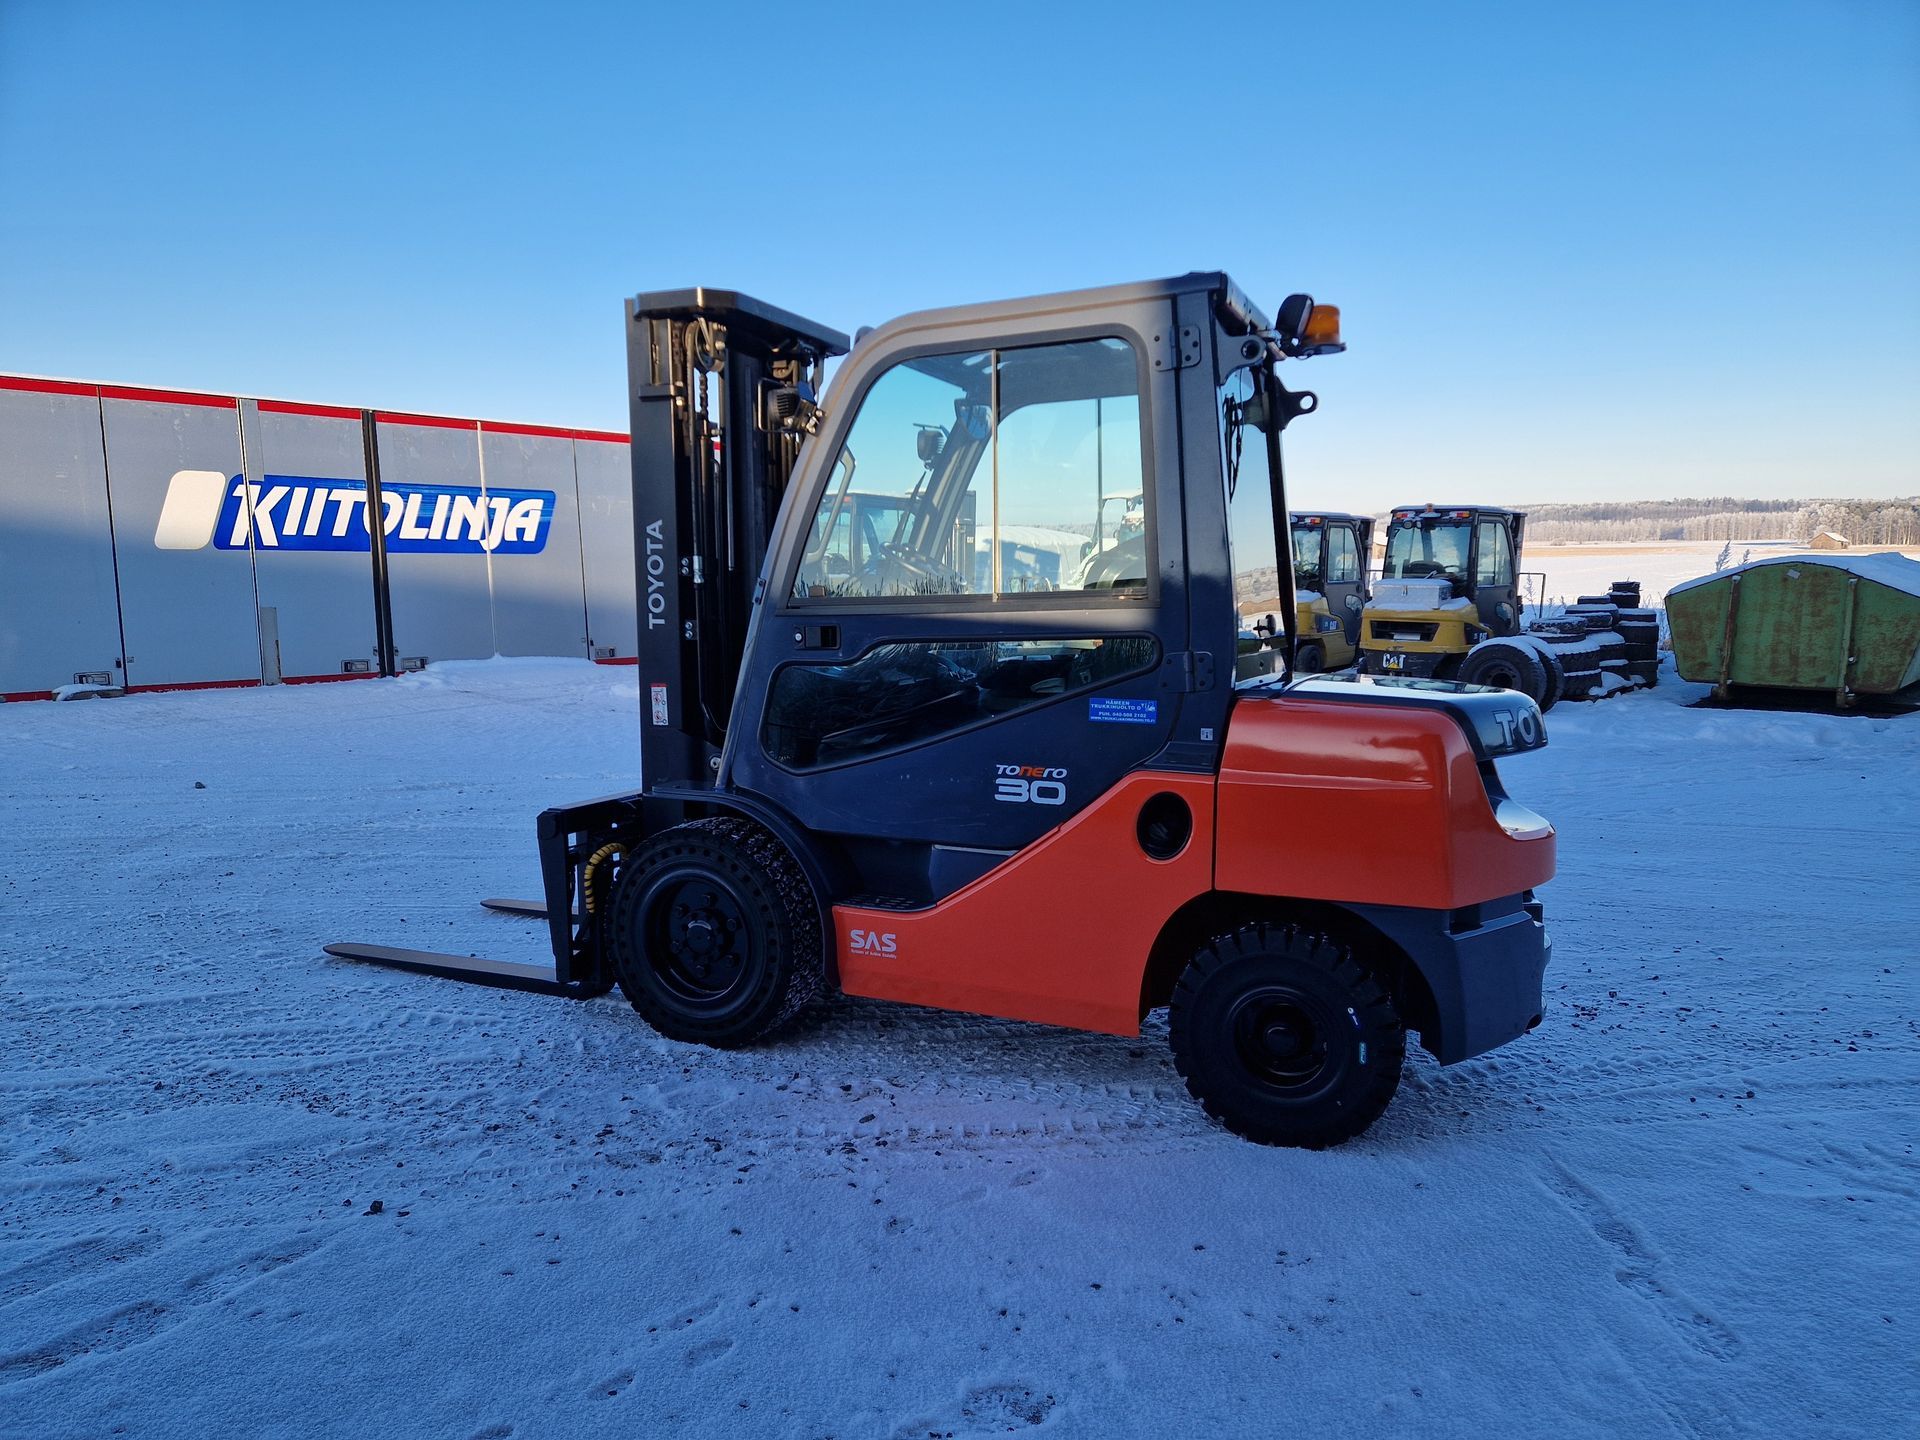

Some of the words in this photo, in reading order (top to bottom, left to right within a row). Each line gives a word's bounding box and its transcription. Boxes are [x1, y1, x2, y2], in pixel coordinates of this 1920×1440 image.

[230, 484, 544, 551] KIITOLINJA
[646, 519, 666, 630] TOYOTA
[1382, 652, 1406, 669] CAT
[994, 777, 1066, 806] 30
[850, 929, 897, 953] SAS
